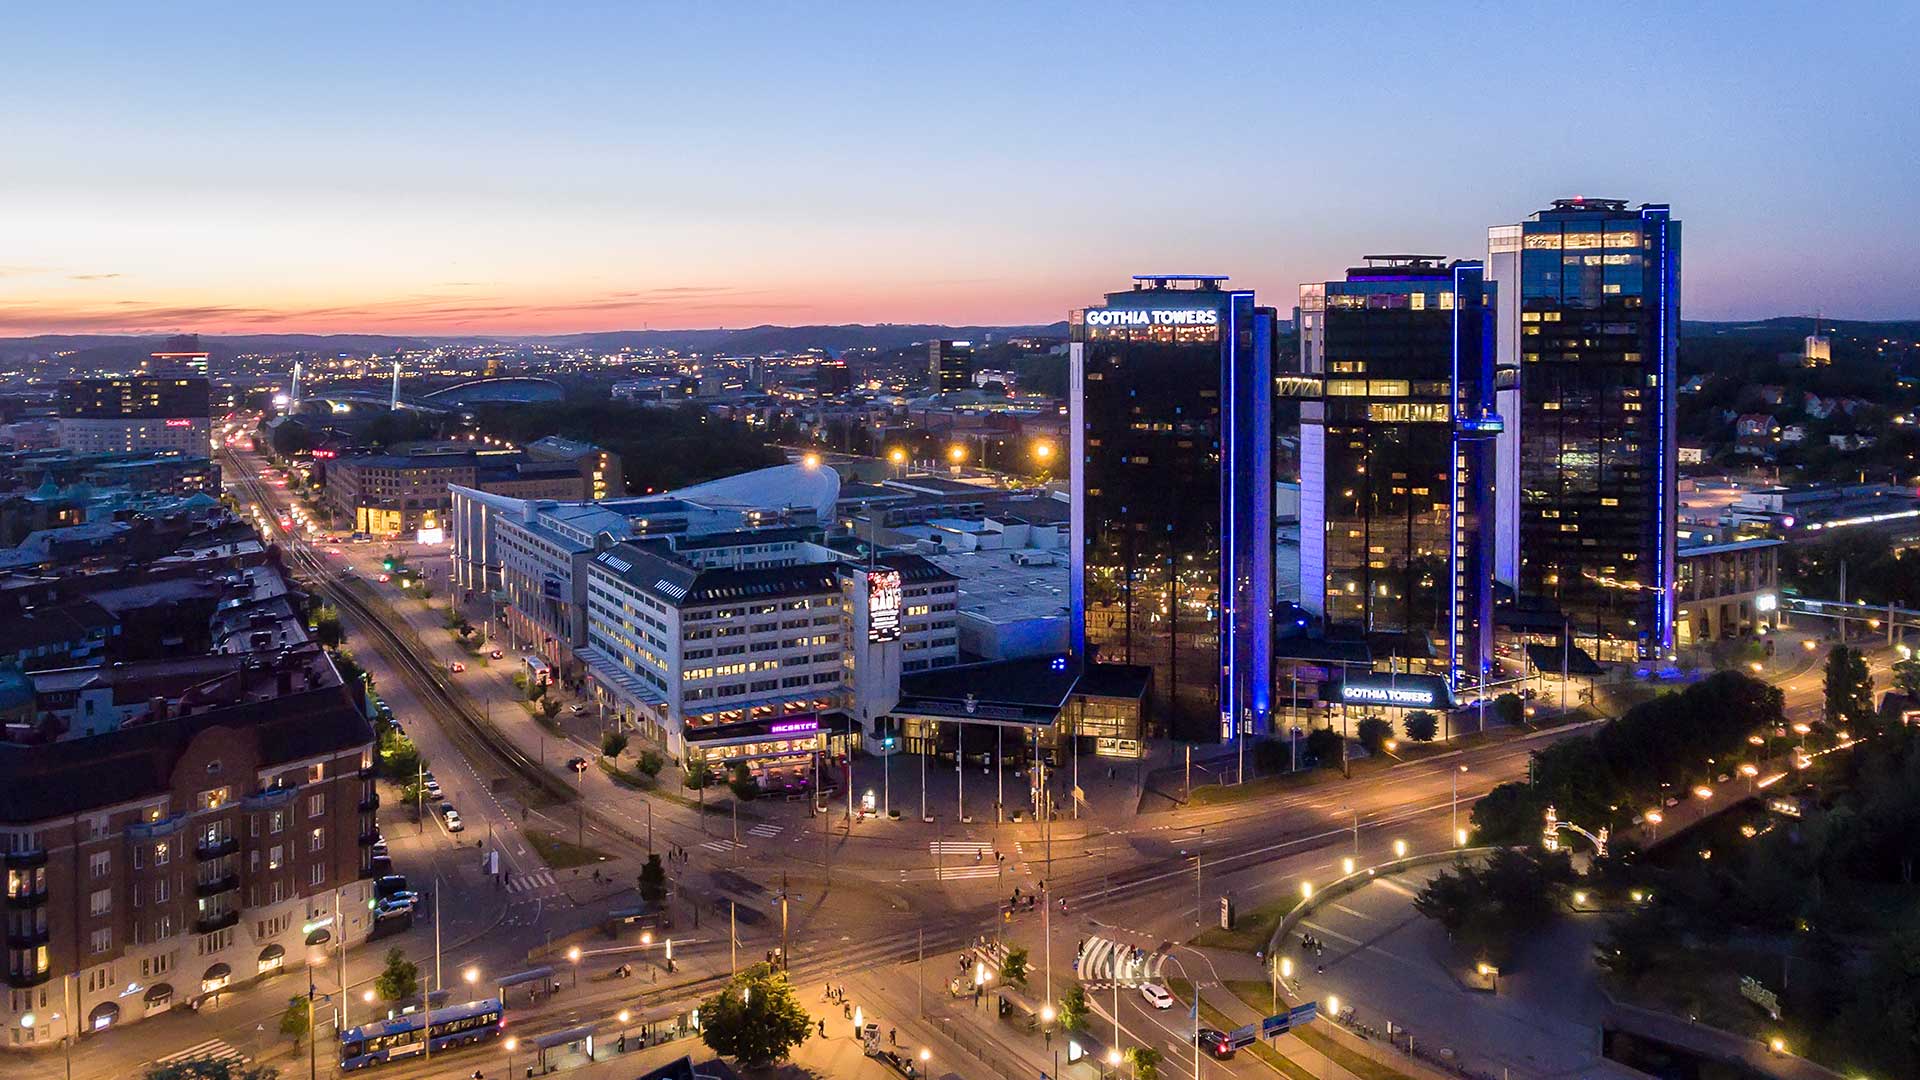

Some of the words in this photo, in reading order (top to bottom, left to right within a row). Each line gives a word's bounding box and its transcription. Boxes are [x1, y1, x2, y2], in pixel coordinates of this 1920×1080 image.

[1086, 310, 1150, 325] GOTHIA
[1151, 310, 1218, 324] TOWERS
[1343, 687, 1388, 700] GOTHIA
[1389, 690, 1433, 703] TOWERS
